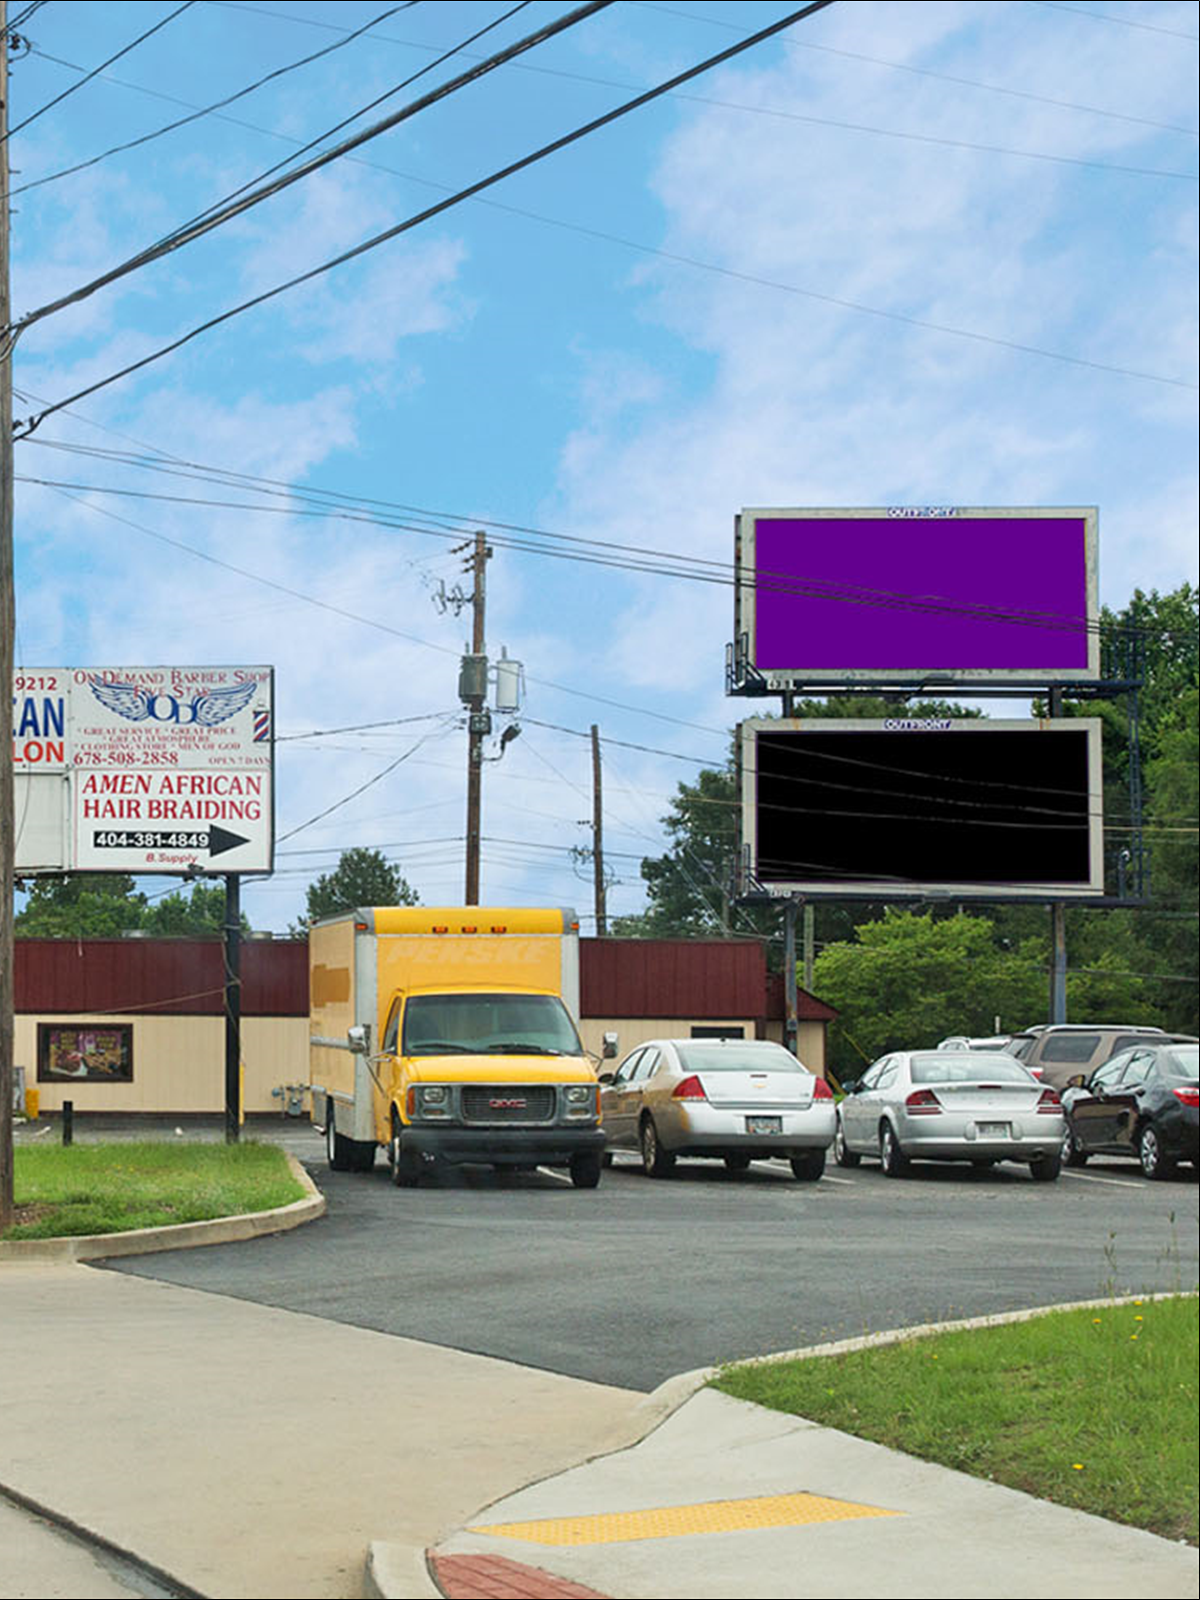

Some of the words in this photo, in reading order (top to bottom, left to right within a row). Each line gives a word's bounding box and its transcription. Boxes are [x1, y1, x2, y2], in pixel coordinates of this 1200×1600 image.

[103, 670, 165, 685] DEMAND
[171, 670, 228, 685] BARBER
[233, 669, 270, 684] SHOP
[12, 741, 64, 762] LON
[73, 751, 179, 766] 678-508-2858
[82, 774, 153, 794] AMEN
[159, 775, 262, 796] AFRICAN
[83, 799, 142, 819] HAIR
[148, 799, 261, 820] BRAIDING
[97, 832, 209, 847] 404-381-4849
